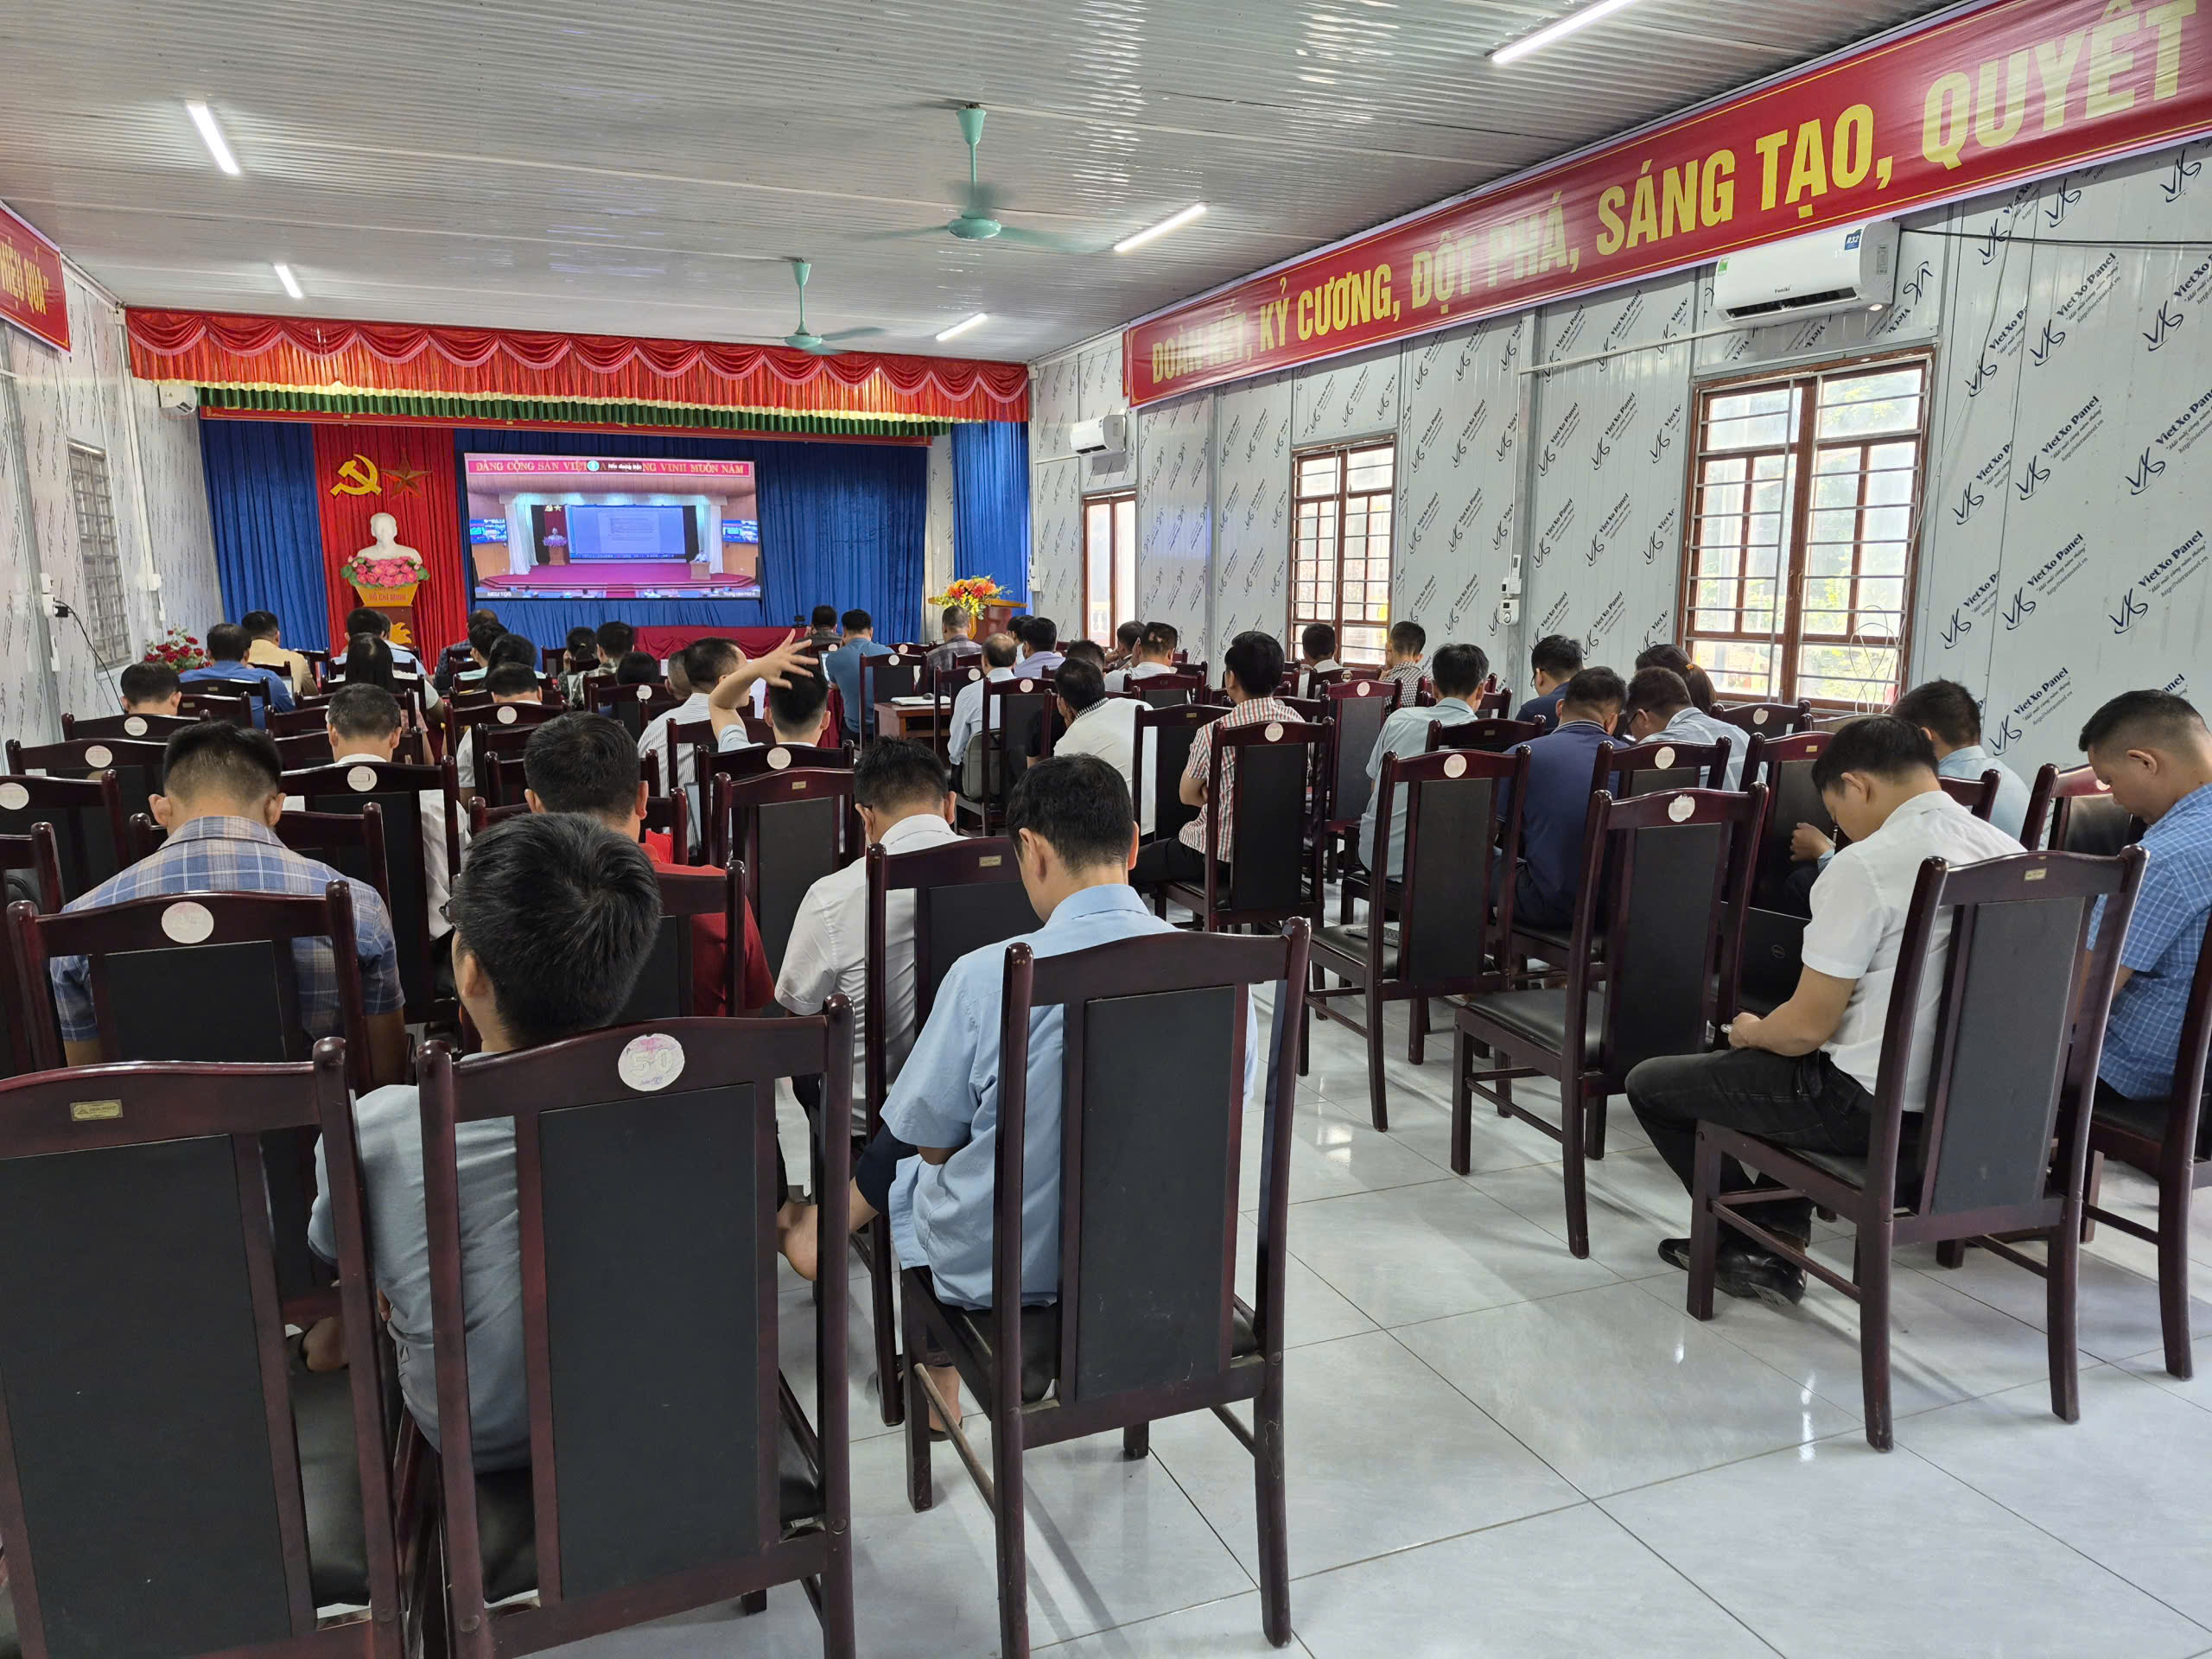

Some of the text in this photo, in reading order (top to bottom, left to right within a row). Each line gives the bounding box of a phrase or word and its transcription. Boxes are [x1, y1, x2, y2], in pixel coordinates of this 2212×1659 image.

[1260, 276, 1290, 353] KỶ
[1297, 264, 1401, 342] CƯƠNG,
[1411, 230, 1478, 315] ĐỘT
[1488, 190, 1580, 288] PHÁ,
[1596, 149, 1736, 256] SÁNG
[1755, 104, 1893, 219] TẠO,
[2056, 252, 2116, 316] VietXo Panel
[2173, 263, 2209, 297] VietXo
[1989, 320, 2018, 350] VietXo
[2041, 396, 2100, 454] VietXo Panel
[2155, 413, 2191, 444] VietXo
[2190, 388, 2212, 414] Pan
[1976, 453, 2004, 480] VietXo
[2027, 533, 2084, 586] VietXo Panel
[2138, 530, 2203, 587] VietXo Panel
[1963, 582, 1991, 607] VietXo
[2013, 667, 2069, 715] VietXo Panel
